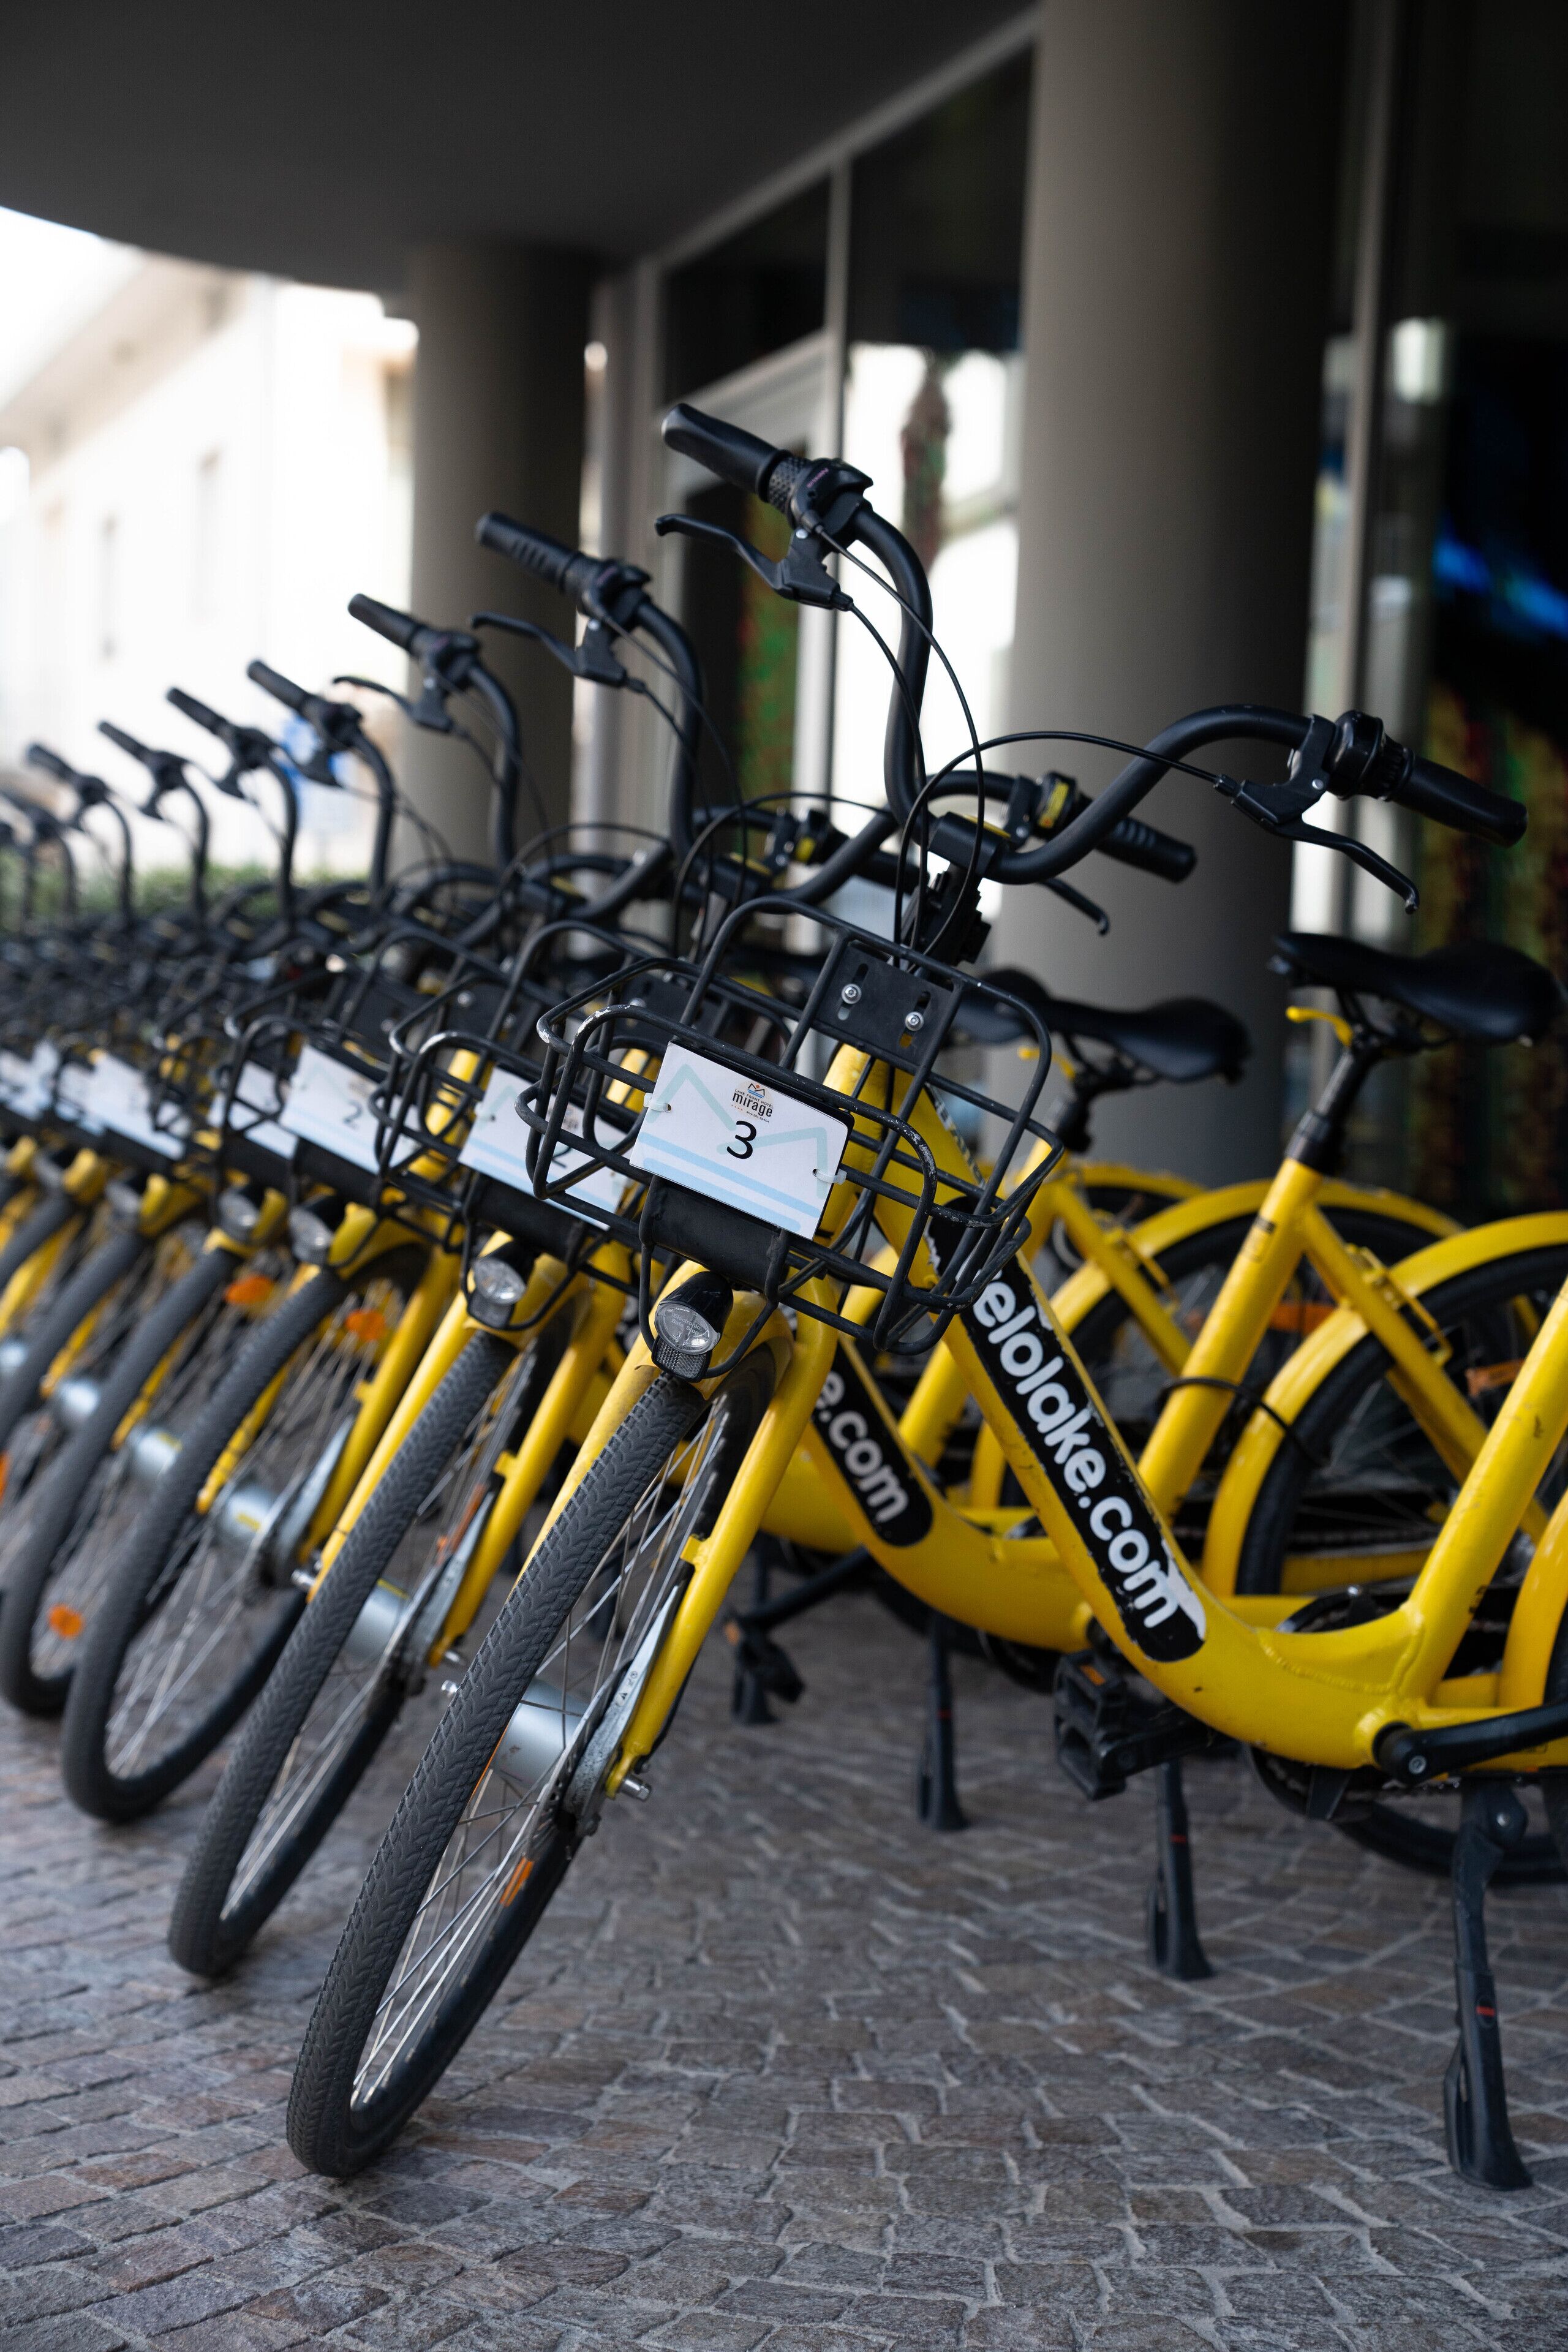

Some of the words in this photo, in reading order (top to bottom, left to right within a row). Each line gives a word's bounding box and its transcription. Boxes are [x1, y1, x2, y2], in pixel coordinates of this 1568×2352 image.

[733, 1093, 772, 1117] mirage
[726, 1120, 757, 1159] 3
[672, 1318, 684, 1327] Safe
[686, 1325, 699, 1335] Stop
[674, 1313, 701, 1330] Electronic
